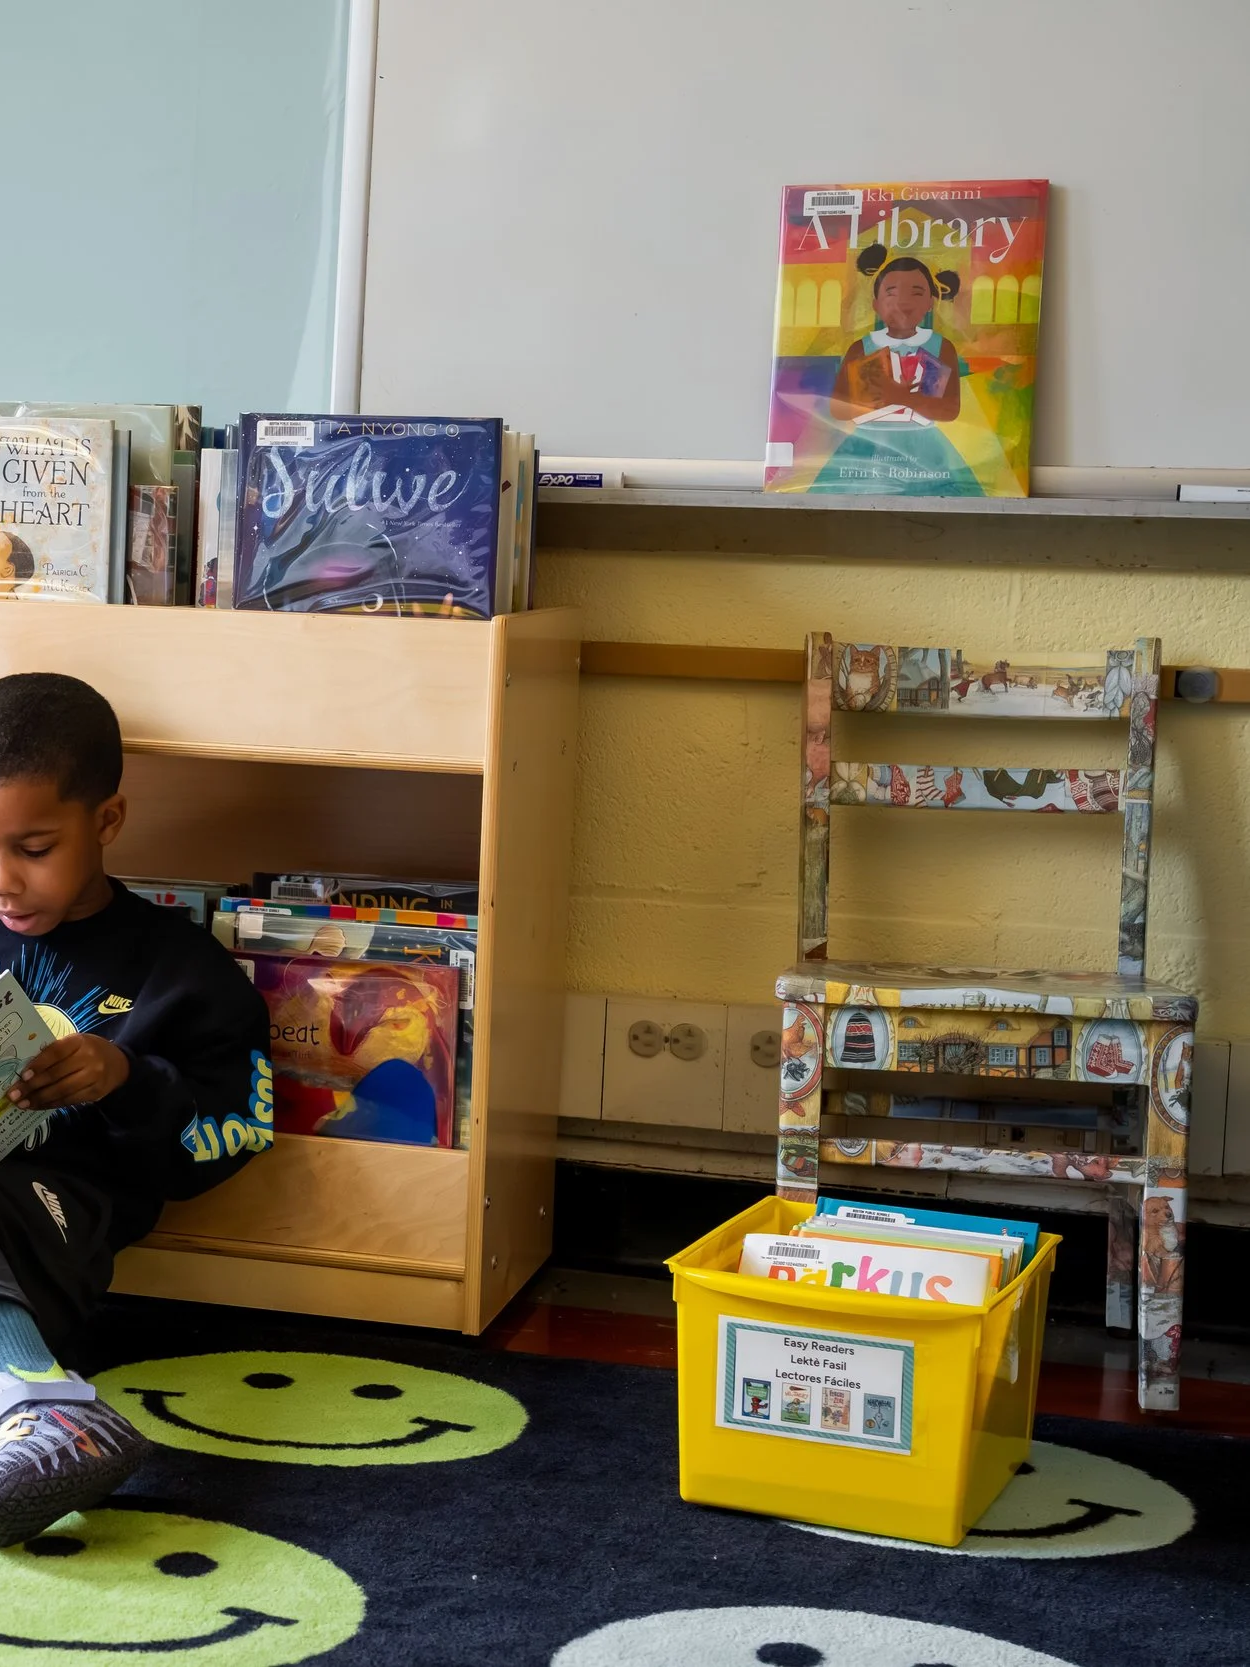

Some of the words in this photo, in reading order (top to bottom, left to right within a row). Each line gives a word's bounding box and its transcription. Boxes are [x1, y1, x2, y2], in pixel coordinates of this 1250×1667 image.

[861, 187, 894, 201] kki
[901, 187, 981, 201] Giovanni
[795, 213, 831, 250] A
[849, 207, 1028, 263] Library
[316, 422, 352, 435] ITA
[362, 422, 460, 438] NYONG'O
[0, 436, 66, 456] WHAT
[74, 438, 92, 456] IS
[2, 459, 90, 486] GIVEN
[262, 441, 473, 519] Sulwe
[538, 474, 574, 486] EXPO
[839, 466, 867, 478] Erin
[888, 467, 951, 479] Robinson
[22, 486, 46, 498] from
[49, 486, 66, 499] the
[0, 500, 90, 526] HEART
[440, 899, 454, 910] IN
[107, 993, 133, 1010] NIKE
[8, 1111, 25, 1126] Can
[43, 1187, 68, 1229] NIKE
[784, 1337, 808, 1351] Easy
[811, 1341, 855, 1356] Readers
[790, 1355, 820, 1368] Lektè
[823, 1358, 847, 1371] Fasil
[775, 1369, 822, 1384] Lectores
[824, 1376, 862, 1390] Fáciles
